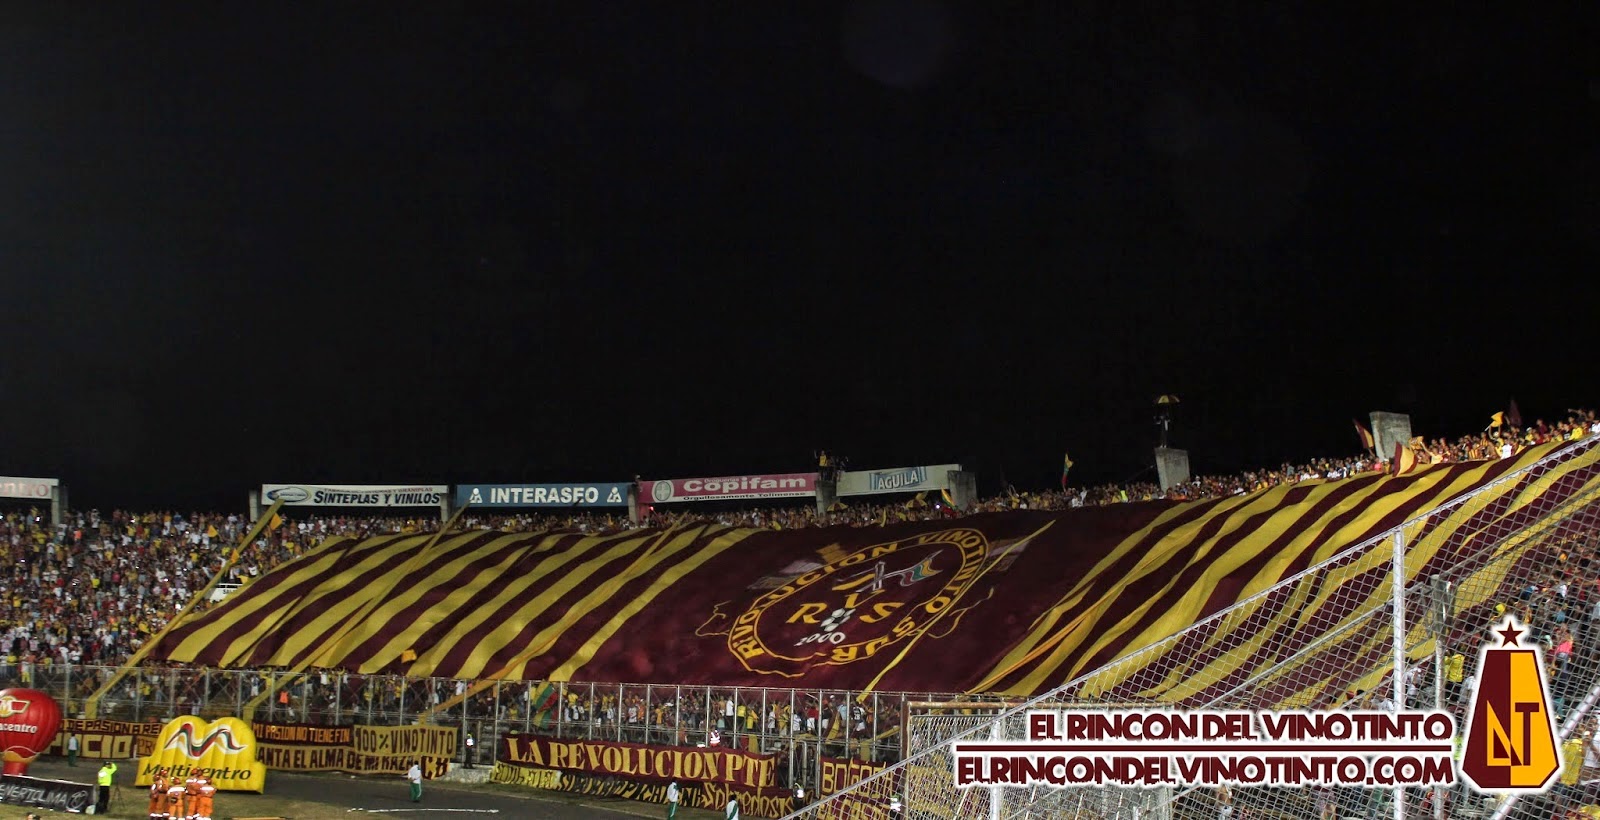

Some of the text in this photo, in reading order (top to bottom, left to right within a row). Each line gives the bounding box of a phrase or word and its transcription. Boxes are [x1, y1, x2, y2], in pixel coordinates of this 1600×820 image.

[683, 477, 806, 493] Copifam
[878, 470, 919, 489] AGUILA
[384, 491, 391, 504] Y
[394, 491, 441, 504] VINILOS
[490, 487, 599, 503] INTERASEO
[253, 722, 351, 743] MI PASION NO TIENE FIN
[391, 728, 454, 755] VINOTINTO
[293, 749, 306, 768] EL
[310, 748, 344, 768] ALMA
[347, 751, 362, 771] DE
[507, 737, 545, 766] LA
[547, 740, 720, 780] REVOLUCION
[725, 753, 776, 787] PTE
[142, 763, 251, 780] Multientro
